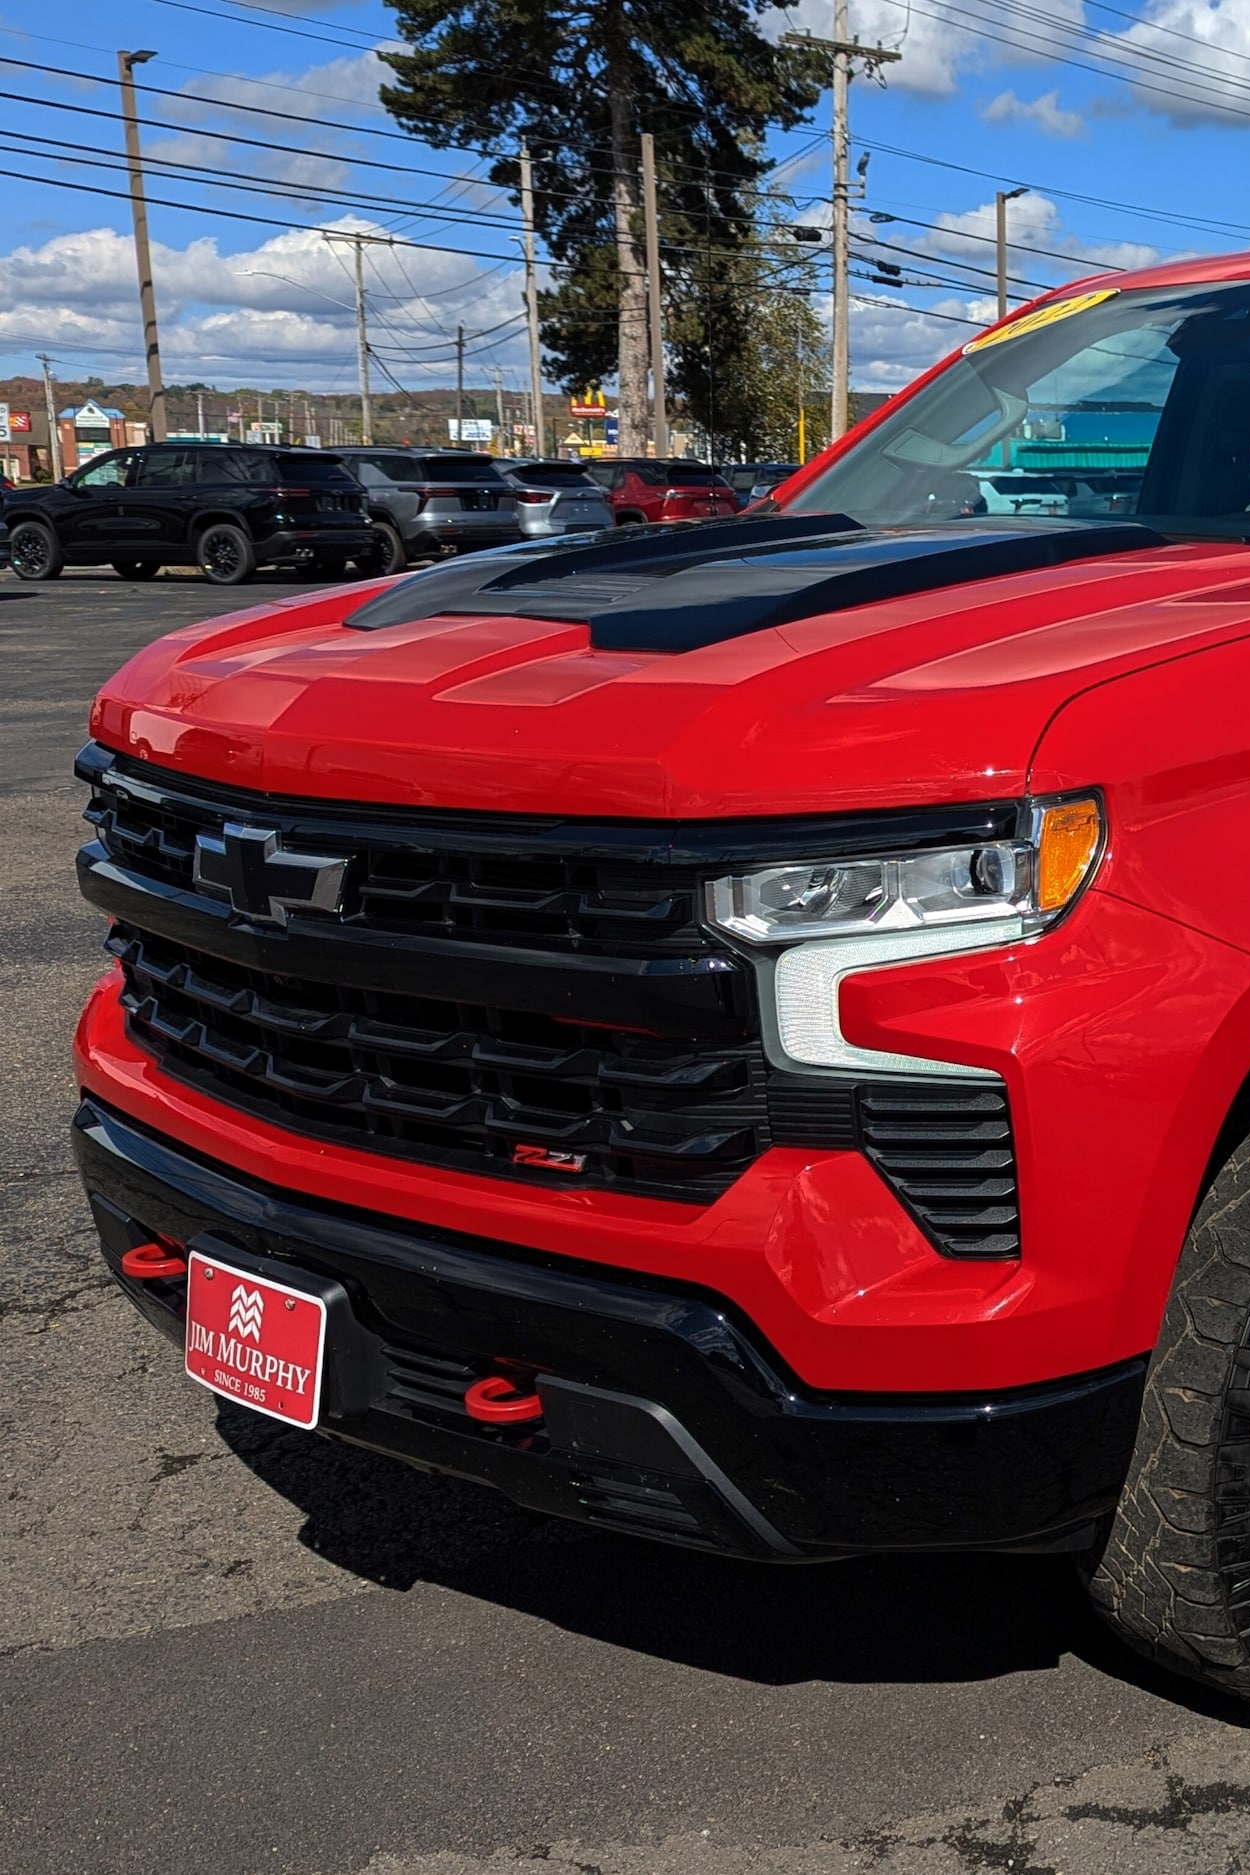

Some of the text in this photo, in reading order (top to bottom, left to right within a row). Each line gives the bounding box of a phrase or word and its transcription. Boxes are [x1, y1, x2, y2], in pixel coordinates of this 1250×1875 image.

[513, 1144, 588, 1173] Z71
[189, 1321, 311, 1394] JIM MURPHY
[214, 1369, 266, 1403] SINCE 1985
